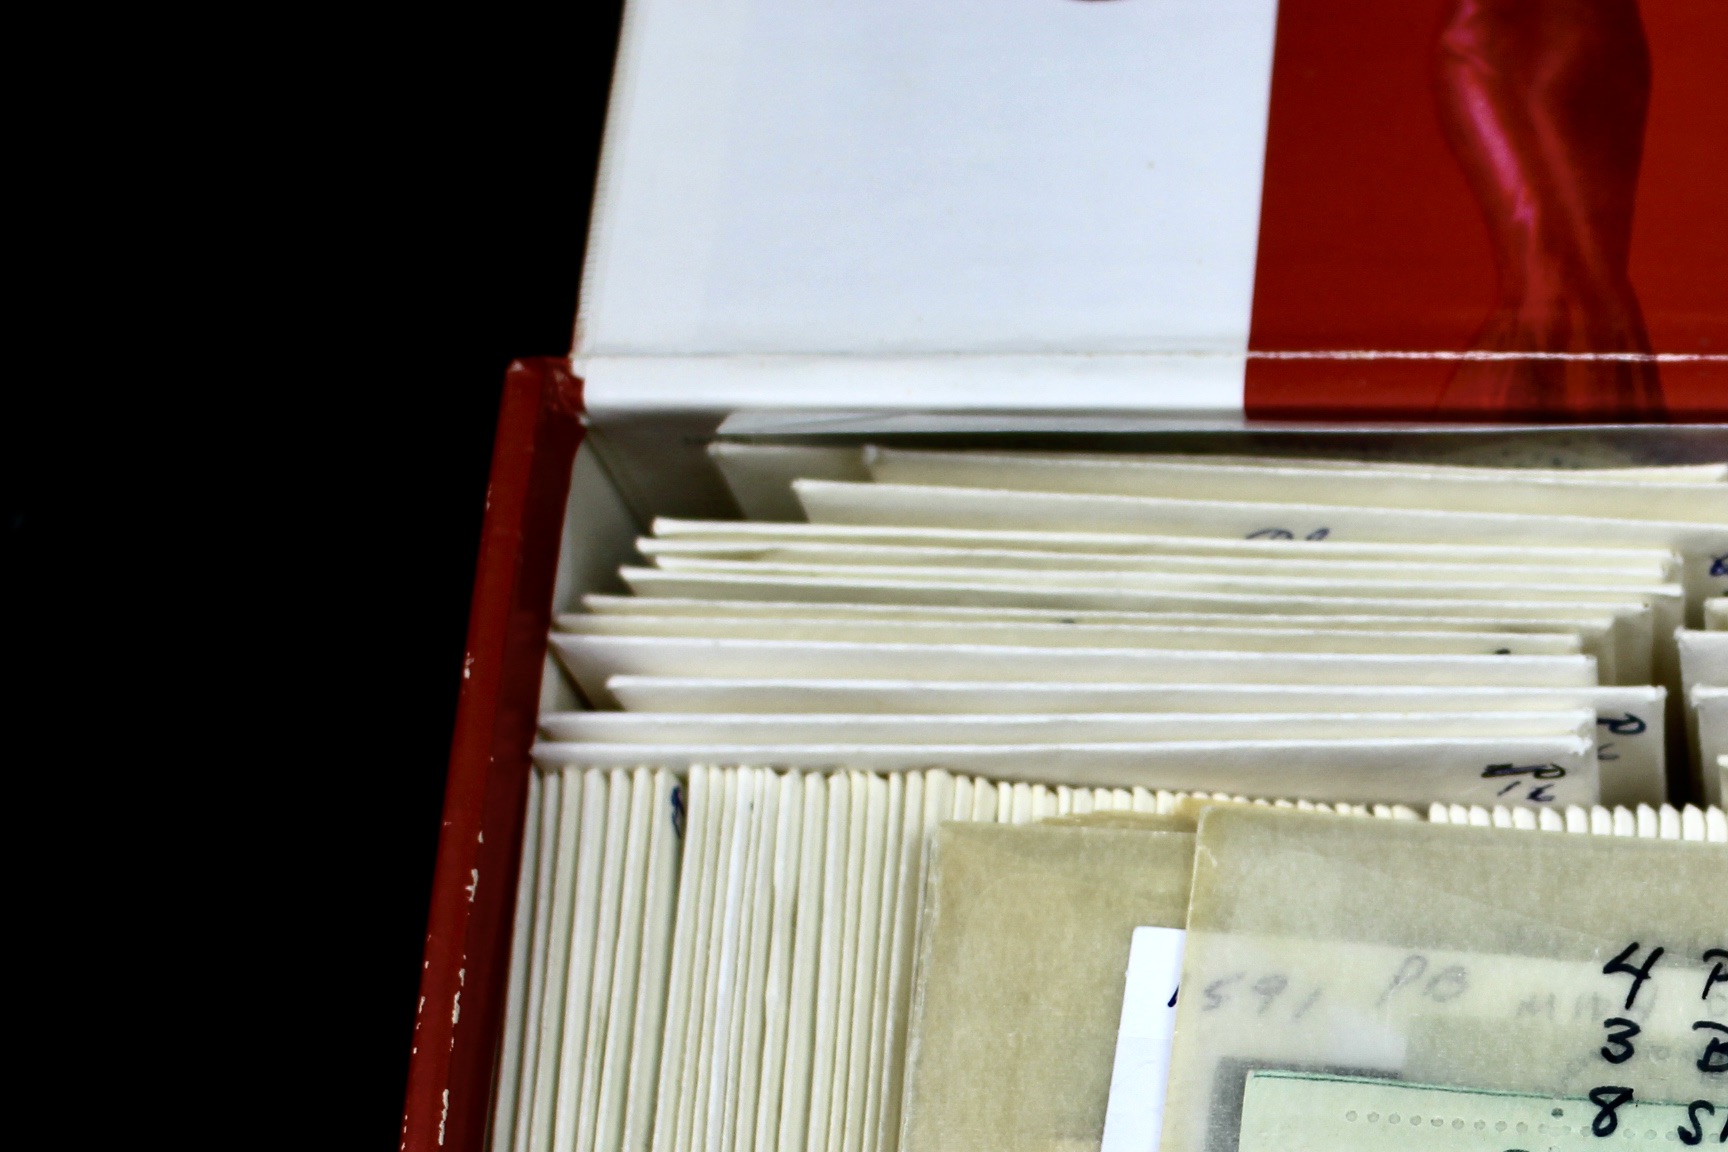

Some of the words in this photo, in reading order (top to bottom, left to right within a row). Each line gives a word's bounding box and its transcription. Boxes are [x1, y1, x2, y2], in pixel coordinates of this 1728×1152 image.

[1602, 941, 1665, 1010] 4
[1600, 1017, 1642, 1065] 3
[1588, 1086, 1634, 1138] 8
